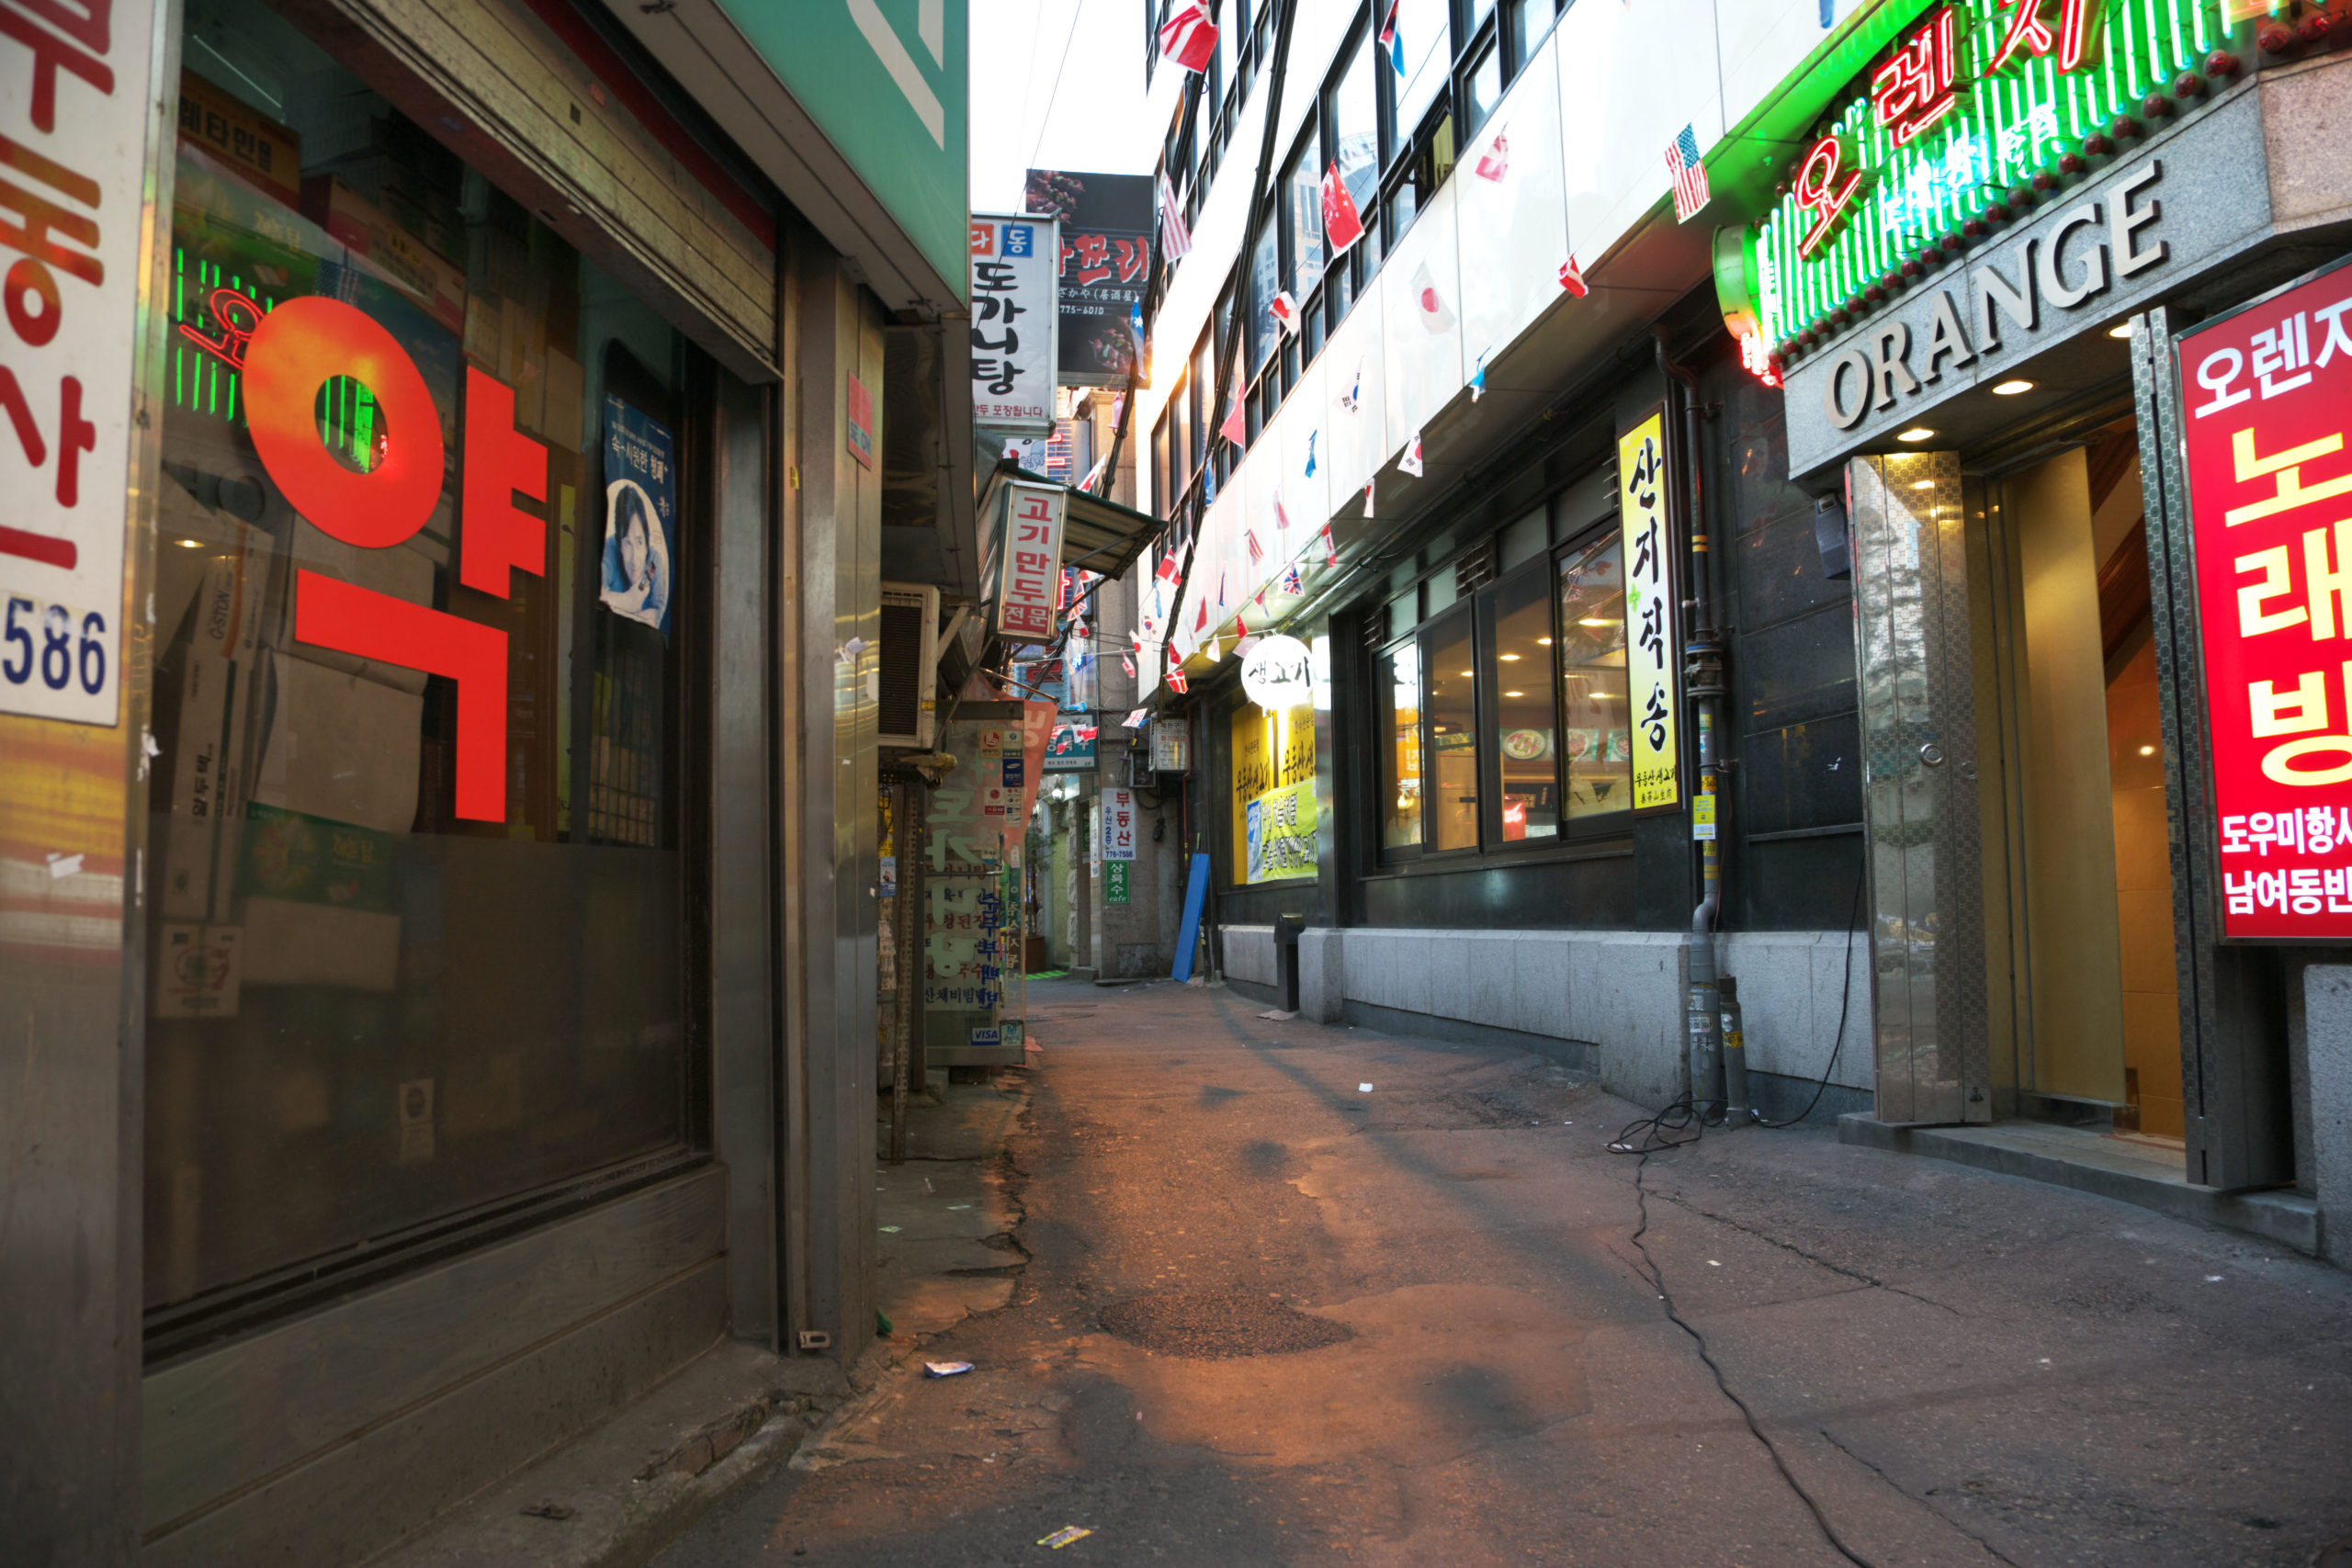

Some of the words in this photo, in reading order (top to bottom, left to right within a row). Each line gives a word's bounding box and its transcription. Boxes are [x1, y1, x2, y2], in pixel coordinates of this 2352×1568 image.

[1059, 305, 1104, 316] 775-6010
[1823, 158, 2170, 430] ORANGE
[971, 262, 1027, 396] 도가니탕
[993, 405, 1043, 417] 포장됩니다
[242, 295, 548, 823] 약
[1003, 605, 1049, 629] 전문
[1628, 437, 1670, 751] 산지직송
[2222, 427, 2352, 786] 노래방
[3, 596, 107, 695] 586
[1116, 792, 1132, 847] 부동산
[1108, 863, 1125, 895] 상록수
[1109, 894, 1127, 903] cafe
[2224, 866, 2352, 915] 남여동반
[975, 1030, 998, 1039] VISA
